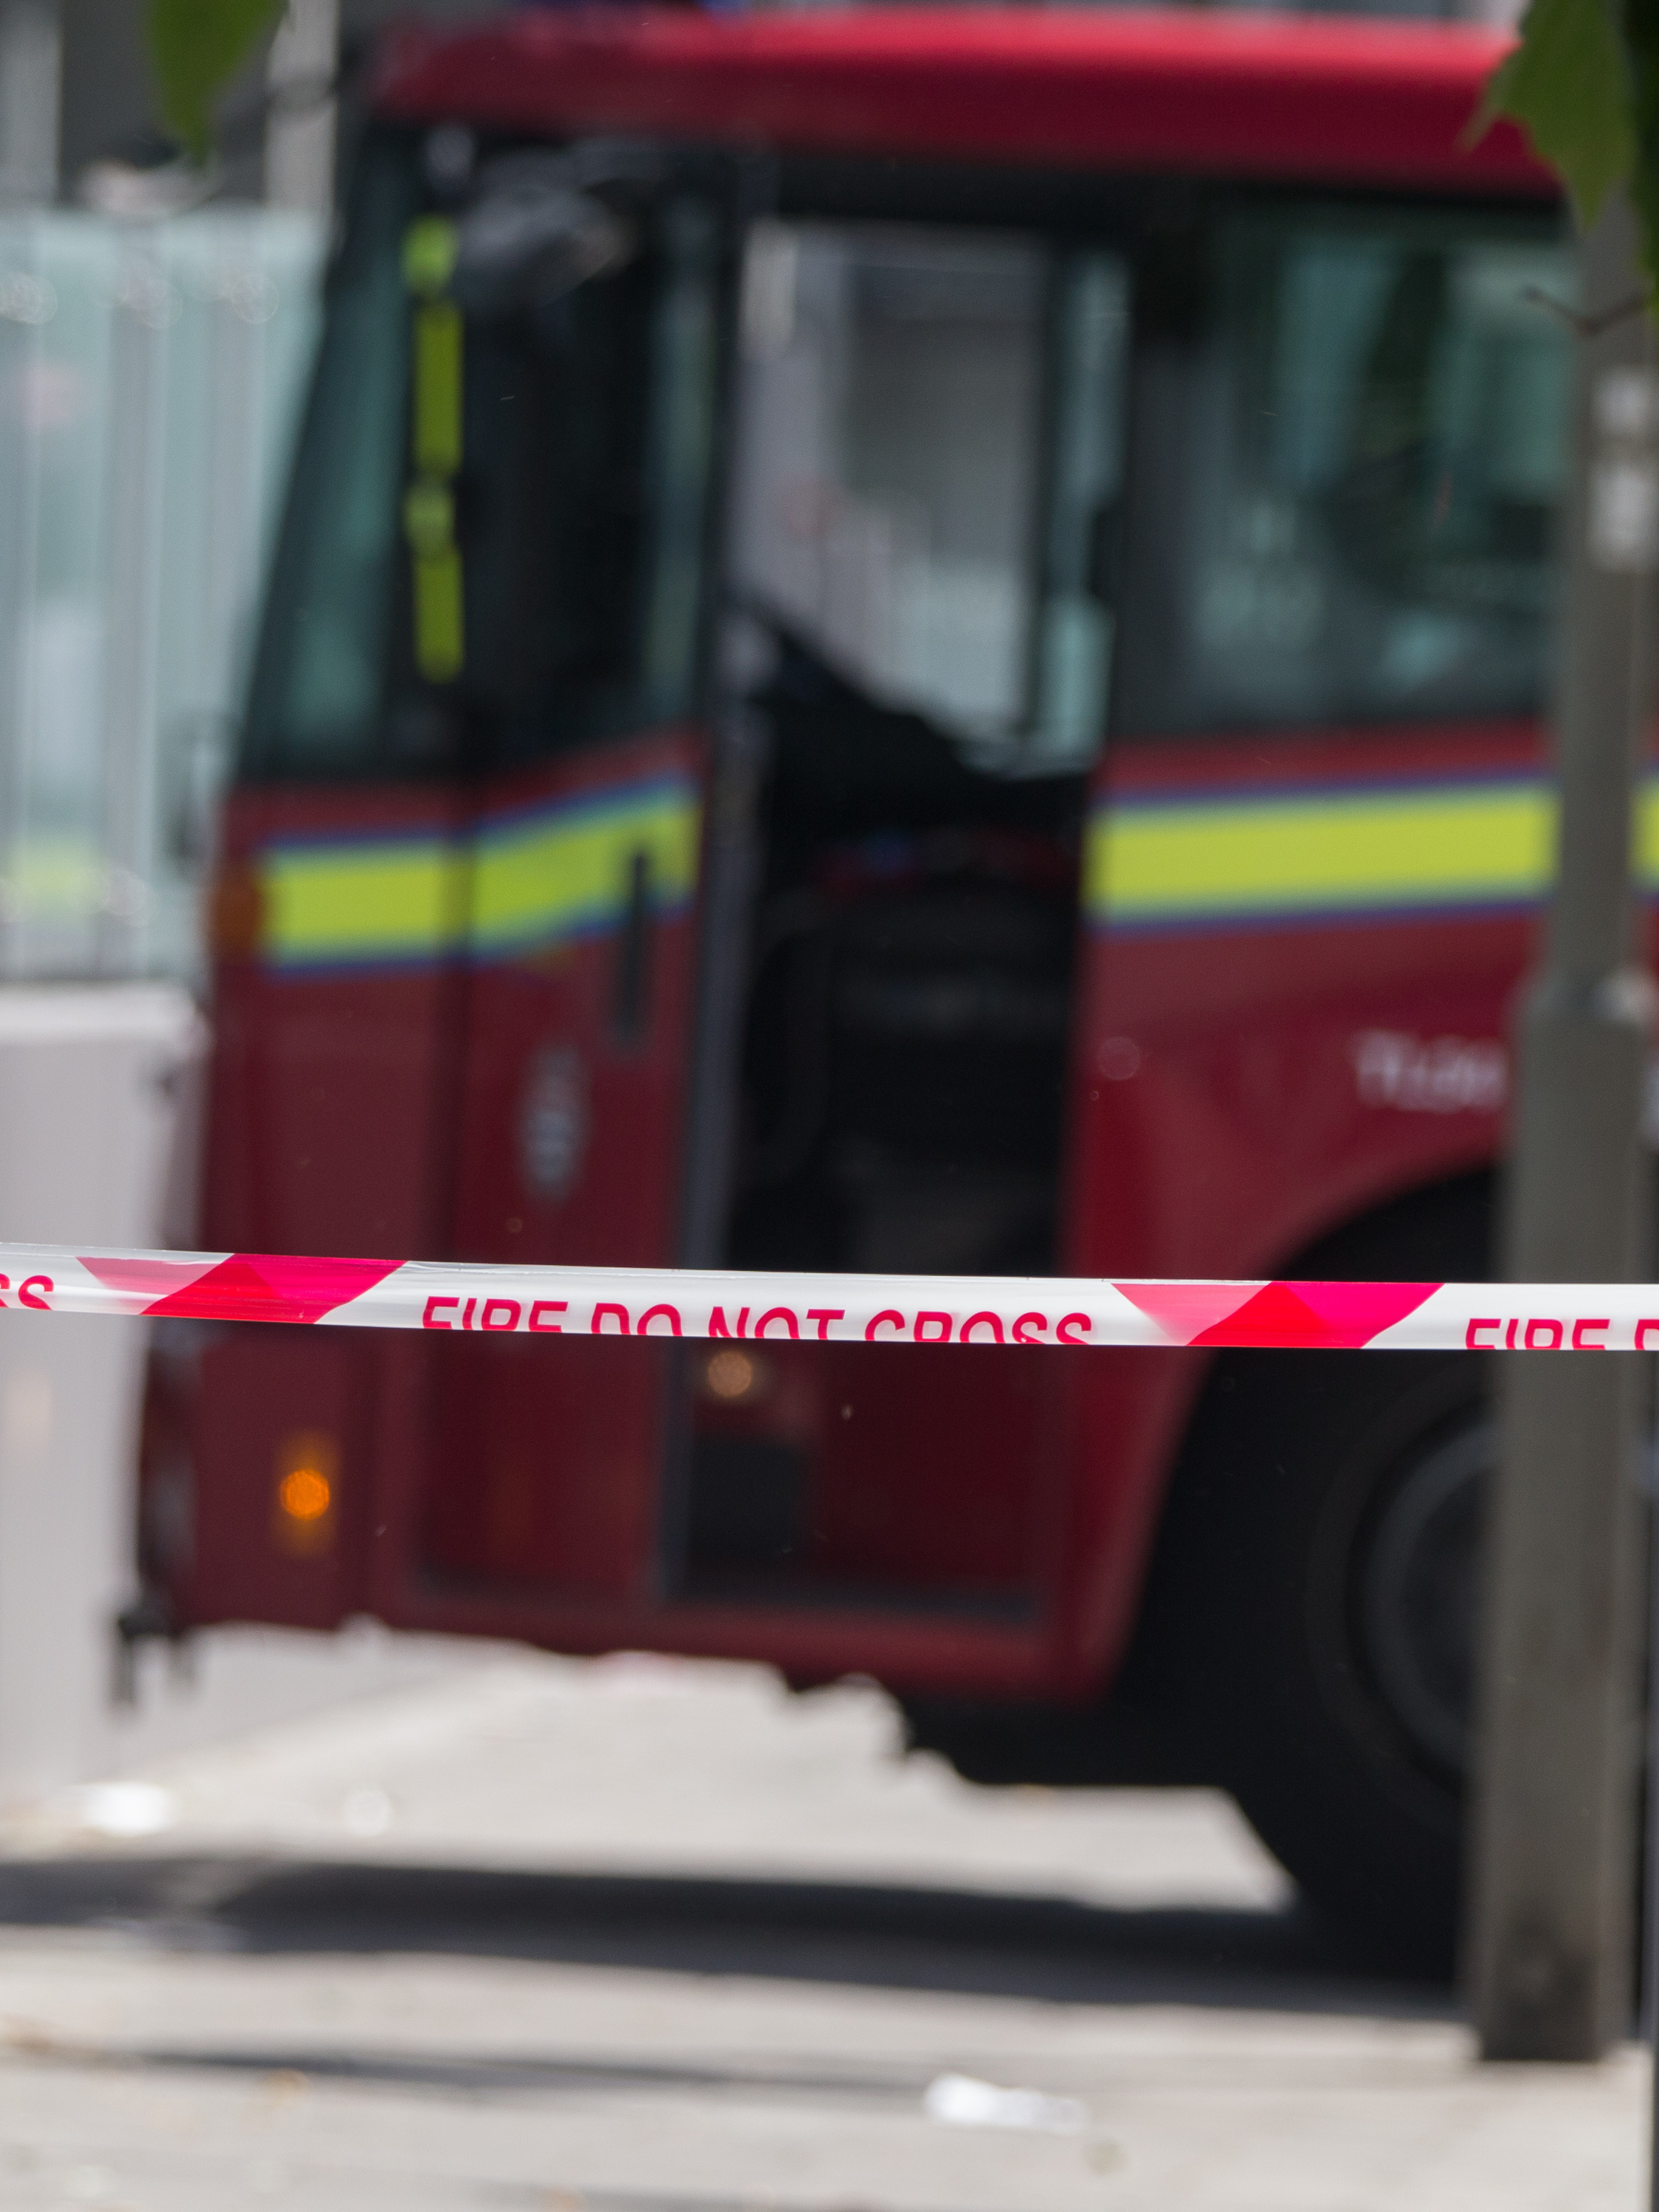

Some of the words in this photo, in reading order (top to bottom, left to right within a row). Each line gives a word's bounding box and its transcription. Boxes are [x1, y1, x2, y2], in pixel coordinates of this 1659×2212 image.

[422, 1295, 569, 1334] FIRE
[590, 1302, 683, 1337] DO
[708, 1306, 846, 1340] NOT
[864, 1309, 1093, 1346] CROSS
[1464, 1318, 1612, 1351] FIRE
